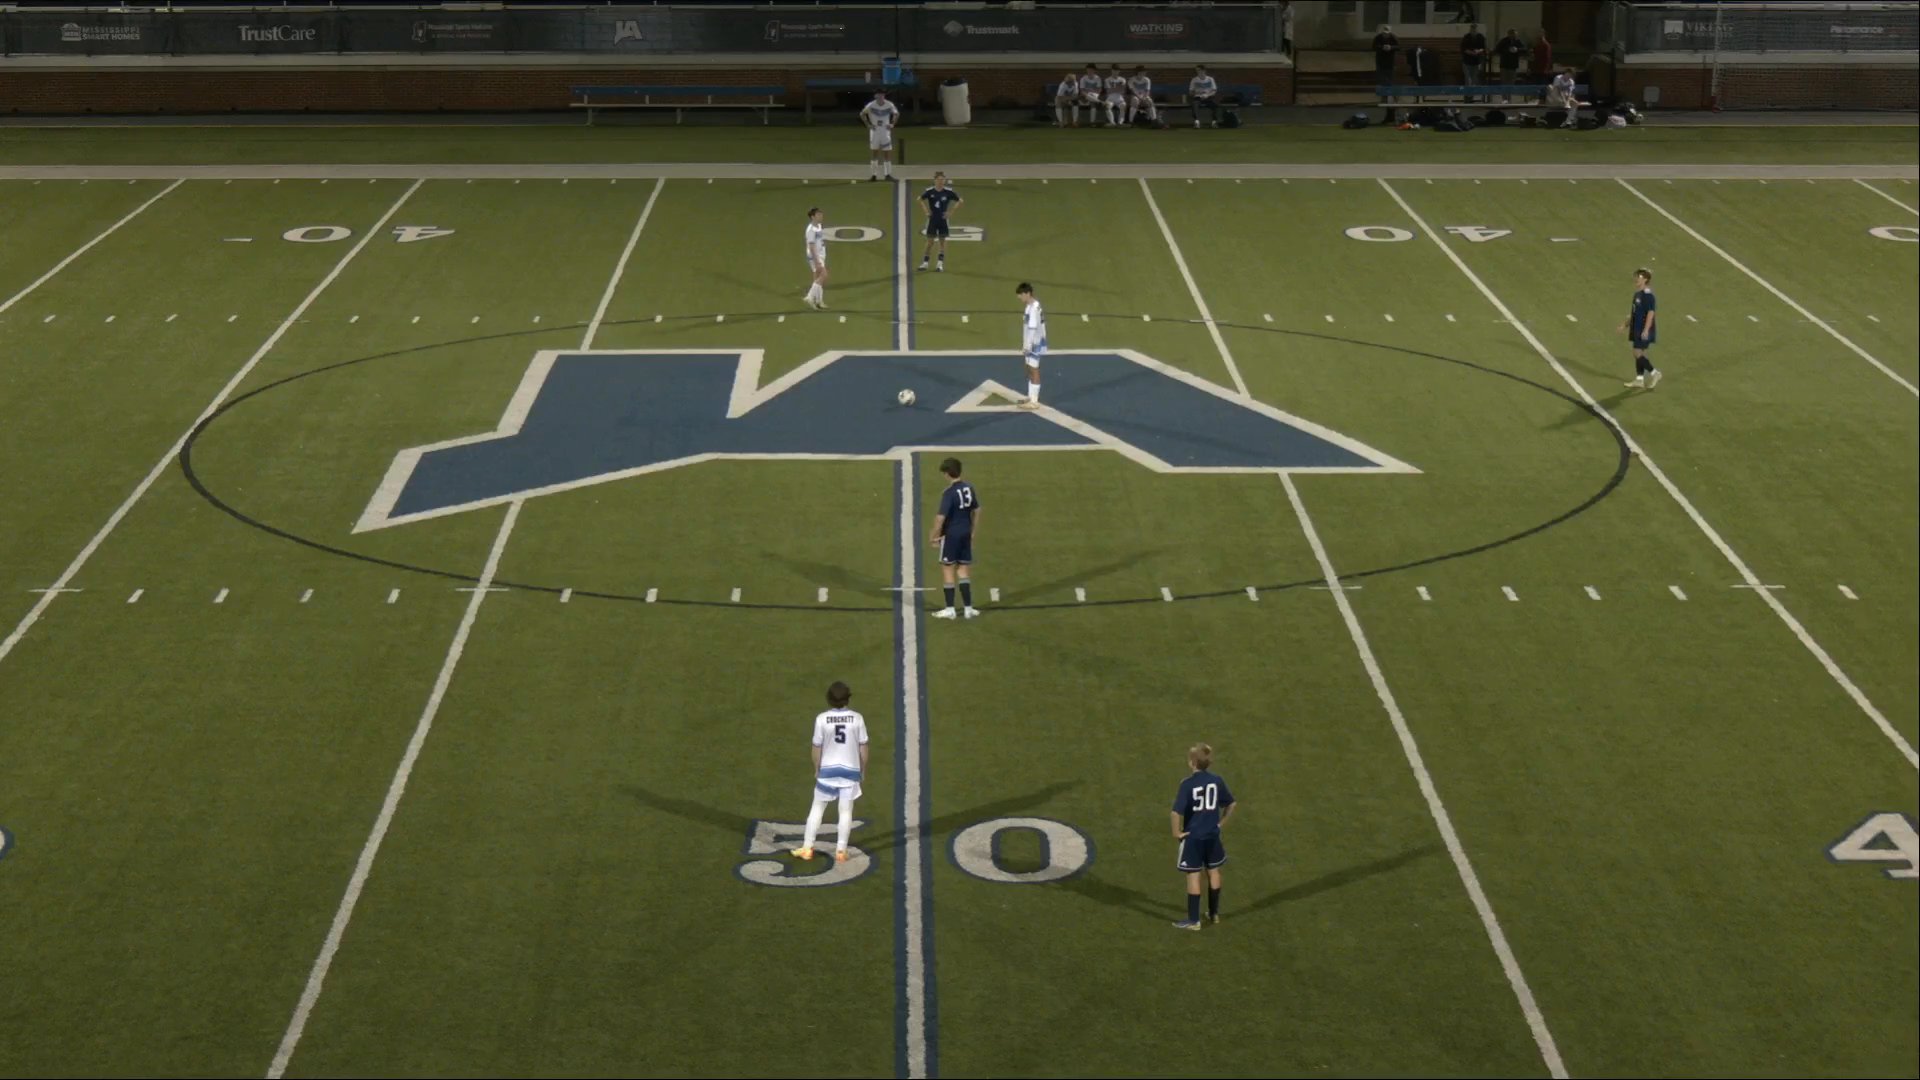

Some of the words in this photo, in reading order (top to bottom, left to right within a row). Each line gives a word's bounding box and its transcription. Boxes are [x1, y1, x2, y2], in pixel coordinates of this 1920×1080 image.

[238, 24, 316, 41] TrustCare
[966, 25, 1019, 34] Trustmark
[1129, 23, 1184, 32] WATKINS
[956, 487, 972, 509] 13
[834, 724, 846, 744] 5
[1192, 783, 1218, 811] 50
